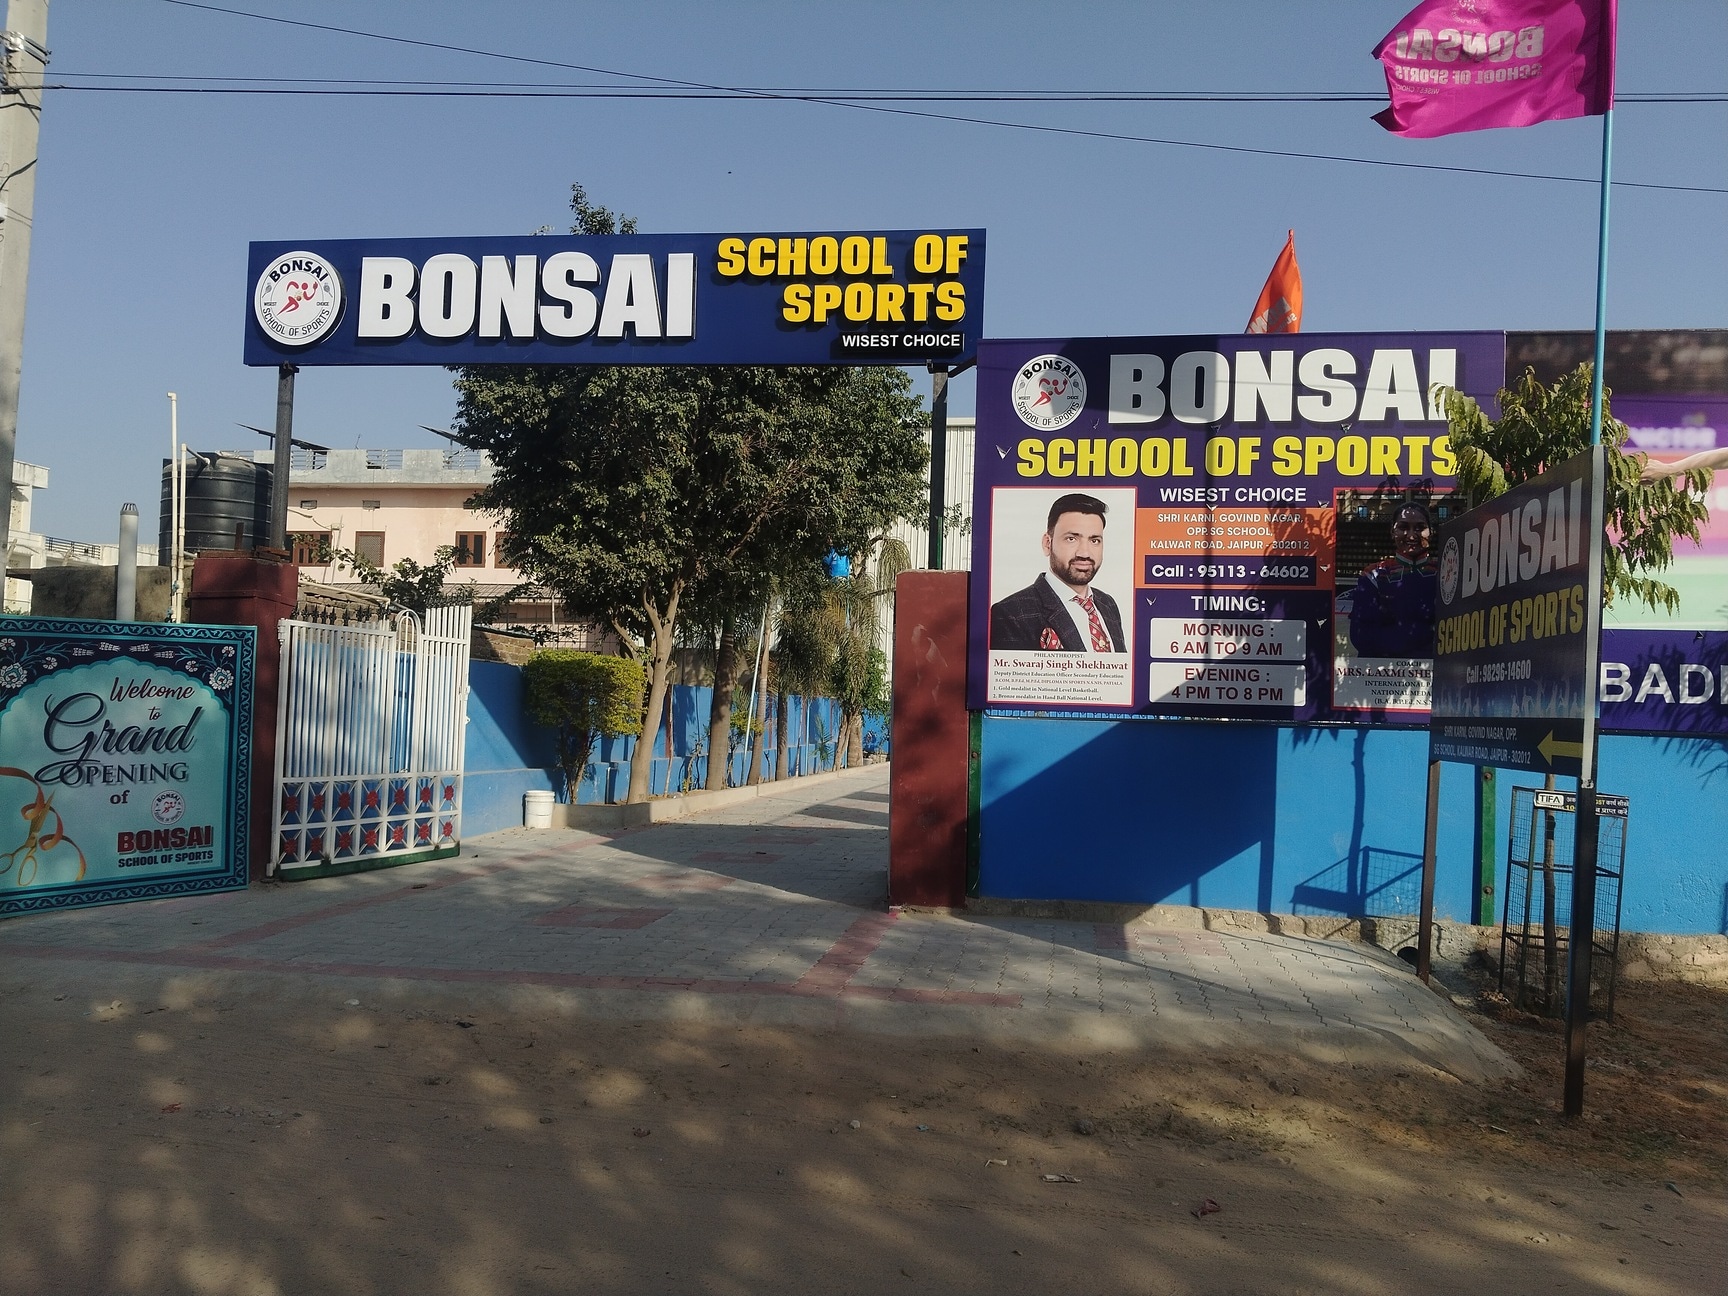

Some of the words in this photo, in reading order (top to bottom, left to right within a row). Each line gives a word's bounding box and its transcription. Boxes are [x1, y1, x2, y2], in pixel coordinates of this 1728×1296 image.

[717, 236, 894, 277] SCHOOL
[914, 234, 968, 274] OF
[269, 260, 328, 282] BONSAI
[358, 252, 697, 338] BONSAI
[782, 281, 966, 323] SPORTS
[263, 307, 286, 335] SCHOOL
[288, 327, 300, 337] OF
[301, 309, 330, 335] SPORTS
[842, 335, 899, 347] WISEST
[903, 334, 961, 347] CHOICE
[1023, 359, 1077, 380] BONSAI
[1108, 348, 1457, 424] BONSAI
[1018, 401, 1040, 425] SCHOOL
[1042, 418, 1052, 426] OF
[1054, 402, 1080, 425] SPORTS
[1016, 437, 1193, 477] SCHOOL
[1205, 436, 1260, 476] OF
[1271, 436, 1458, 477] SPORTS
[1160, 488, 1230, 502] WISEST
[1235, 488, 1307, 502] CHOICE
[1158, 514, 1180, 523] SHRI
[1184, 514, 1217, 524] KARNI,
[1219, 514, 1261, 523] GOVIND
[1264, 514, 1304, 524] NAGAR,
[1210, 527, 1224, 536] SG
[1227, 527, 1273, 537] SCHOOL,
[1462, 478, 1583, 598] BONSAI
[1150, 540, 1191, 549] KALWAR
[1194, 540, 1226, 550] ROAD,
[1227, 540, 1263, 549] JAIPUR
[1272, 540, 1309, 549] 302012
[1151, 564, 1184, 578] Call
[1197, 565, 1246, 578] 95113
[1260, 565, 1309, 578] 64602
[1191, 595, 1266, 612] TIMING:
[1437, 609, 1485, 656] SCHOOL
[1489, 602, 1508, 647] OF
[1510, 584, 1584, 644] SPORTS
[1183, 623, 1264, 637] MORNING
[1170, 641, 1179, 654] 6
[1183, 641, 1209, 654] AM
[1214, 642, 1237, 655] TO
[1242, 642, 1251, 655] 9
[1256, 642, 1282, 655] AM
[994, 658, 1010, 667] Mr.
[1012, 659, 1044, 670] Swaraj
[1046, 659, 1073, 671] Singh
[1075, 660, 1128, 670] Shekhawat
[1337, 667, 1365, 677] MRS.
[1368, 668, 1406, 677] LAXMI
[1408, 669, 1433, 678] SHE
[1184, 668, 1260, 682] EVENING
[1466, 666, 1479, 684] Call
[1600, 662, 1728, 704] BAD
[110, 677, 195, 702] Welcome
[1171, 686, 1181, 699] 4
[1186, 686, 1210, 699] PM
[1215, 687, 1238, 700] TO
[1243, 687, 1252, 700] 8
[1258, 688, 1283, 701] PM
[148, 706, 162, 721] to
[39, 693, 202, 770] Grand
[1444, 726, 1454, 737] SHRI
[1468, 727, 1486, 739] GOVIND
[1490, 749, 1507, 761] JAIPUR
[1512, 750, 1531, 764] 302012
[59, 762, 187, 785] OPENING
[110, 790, 130, 804] of
[156, 793, 181, 803] BONSAI
[1540, 795, 1560, 804] TIFA
[118, 825, 213, 853] BONSAI
[118, 855, 158, 868] SCHOOL
[161, 854, 173, 864] OF
[175, 850, 213, 863] SPORTS
